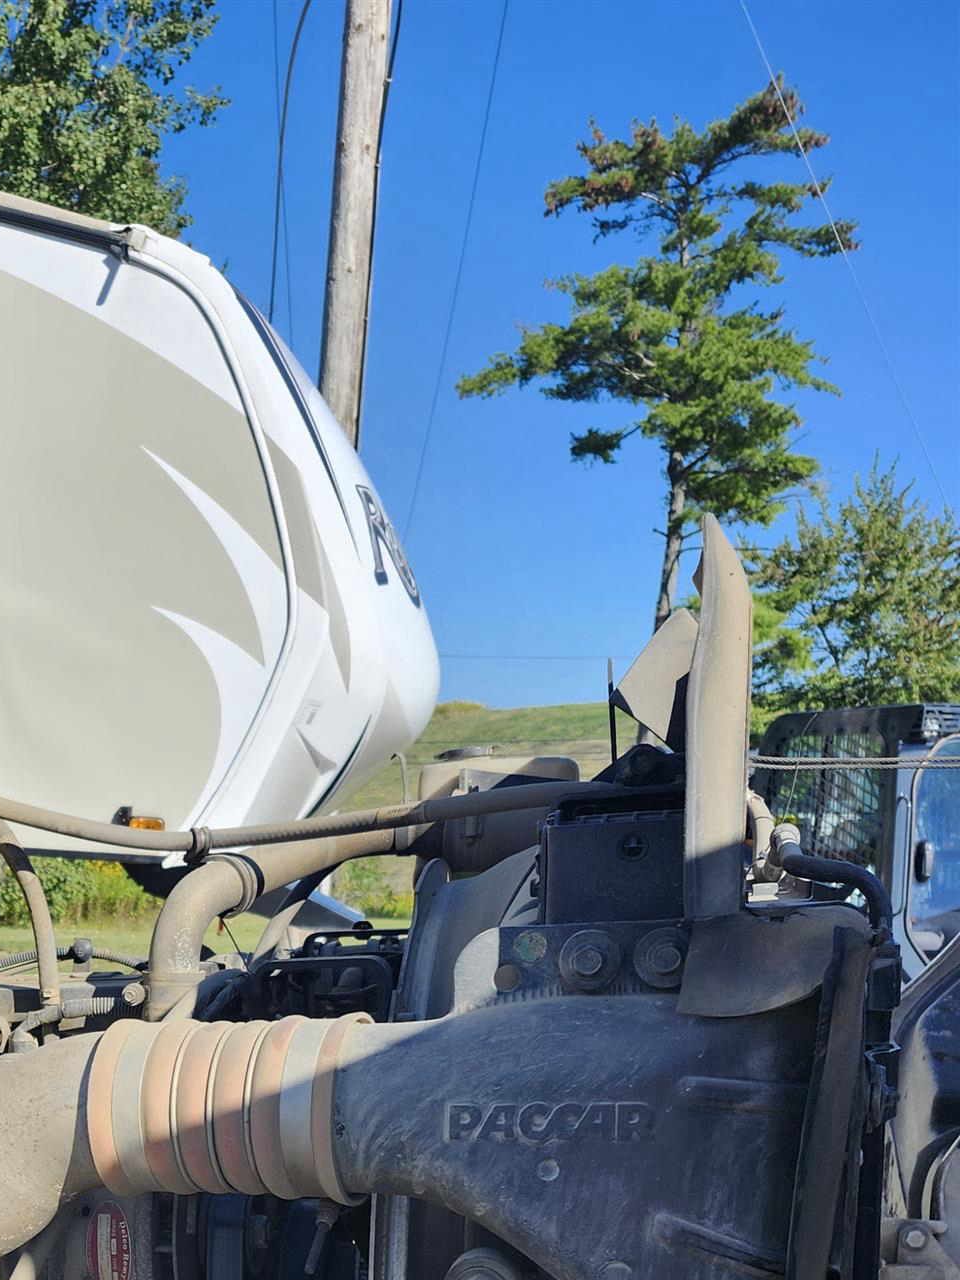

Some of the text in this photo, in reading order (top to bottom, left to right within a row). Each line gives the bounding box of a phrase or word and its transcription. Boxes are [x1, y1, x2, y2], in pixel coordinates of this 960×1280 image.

[444, 1100, 656, 1145] PACCAR
[118, 1219, 130, 1280] Delco Remy
